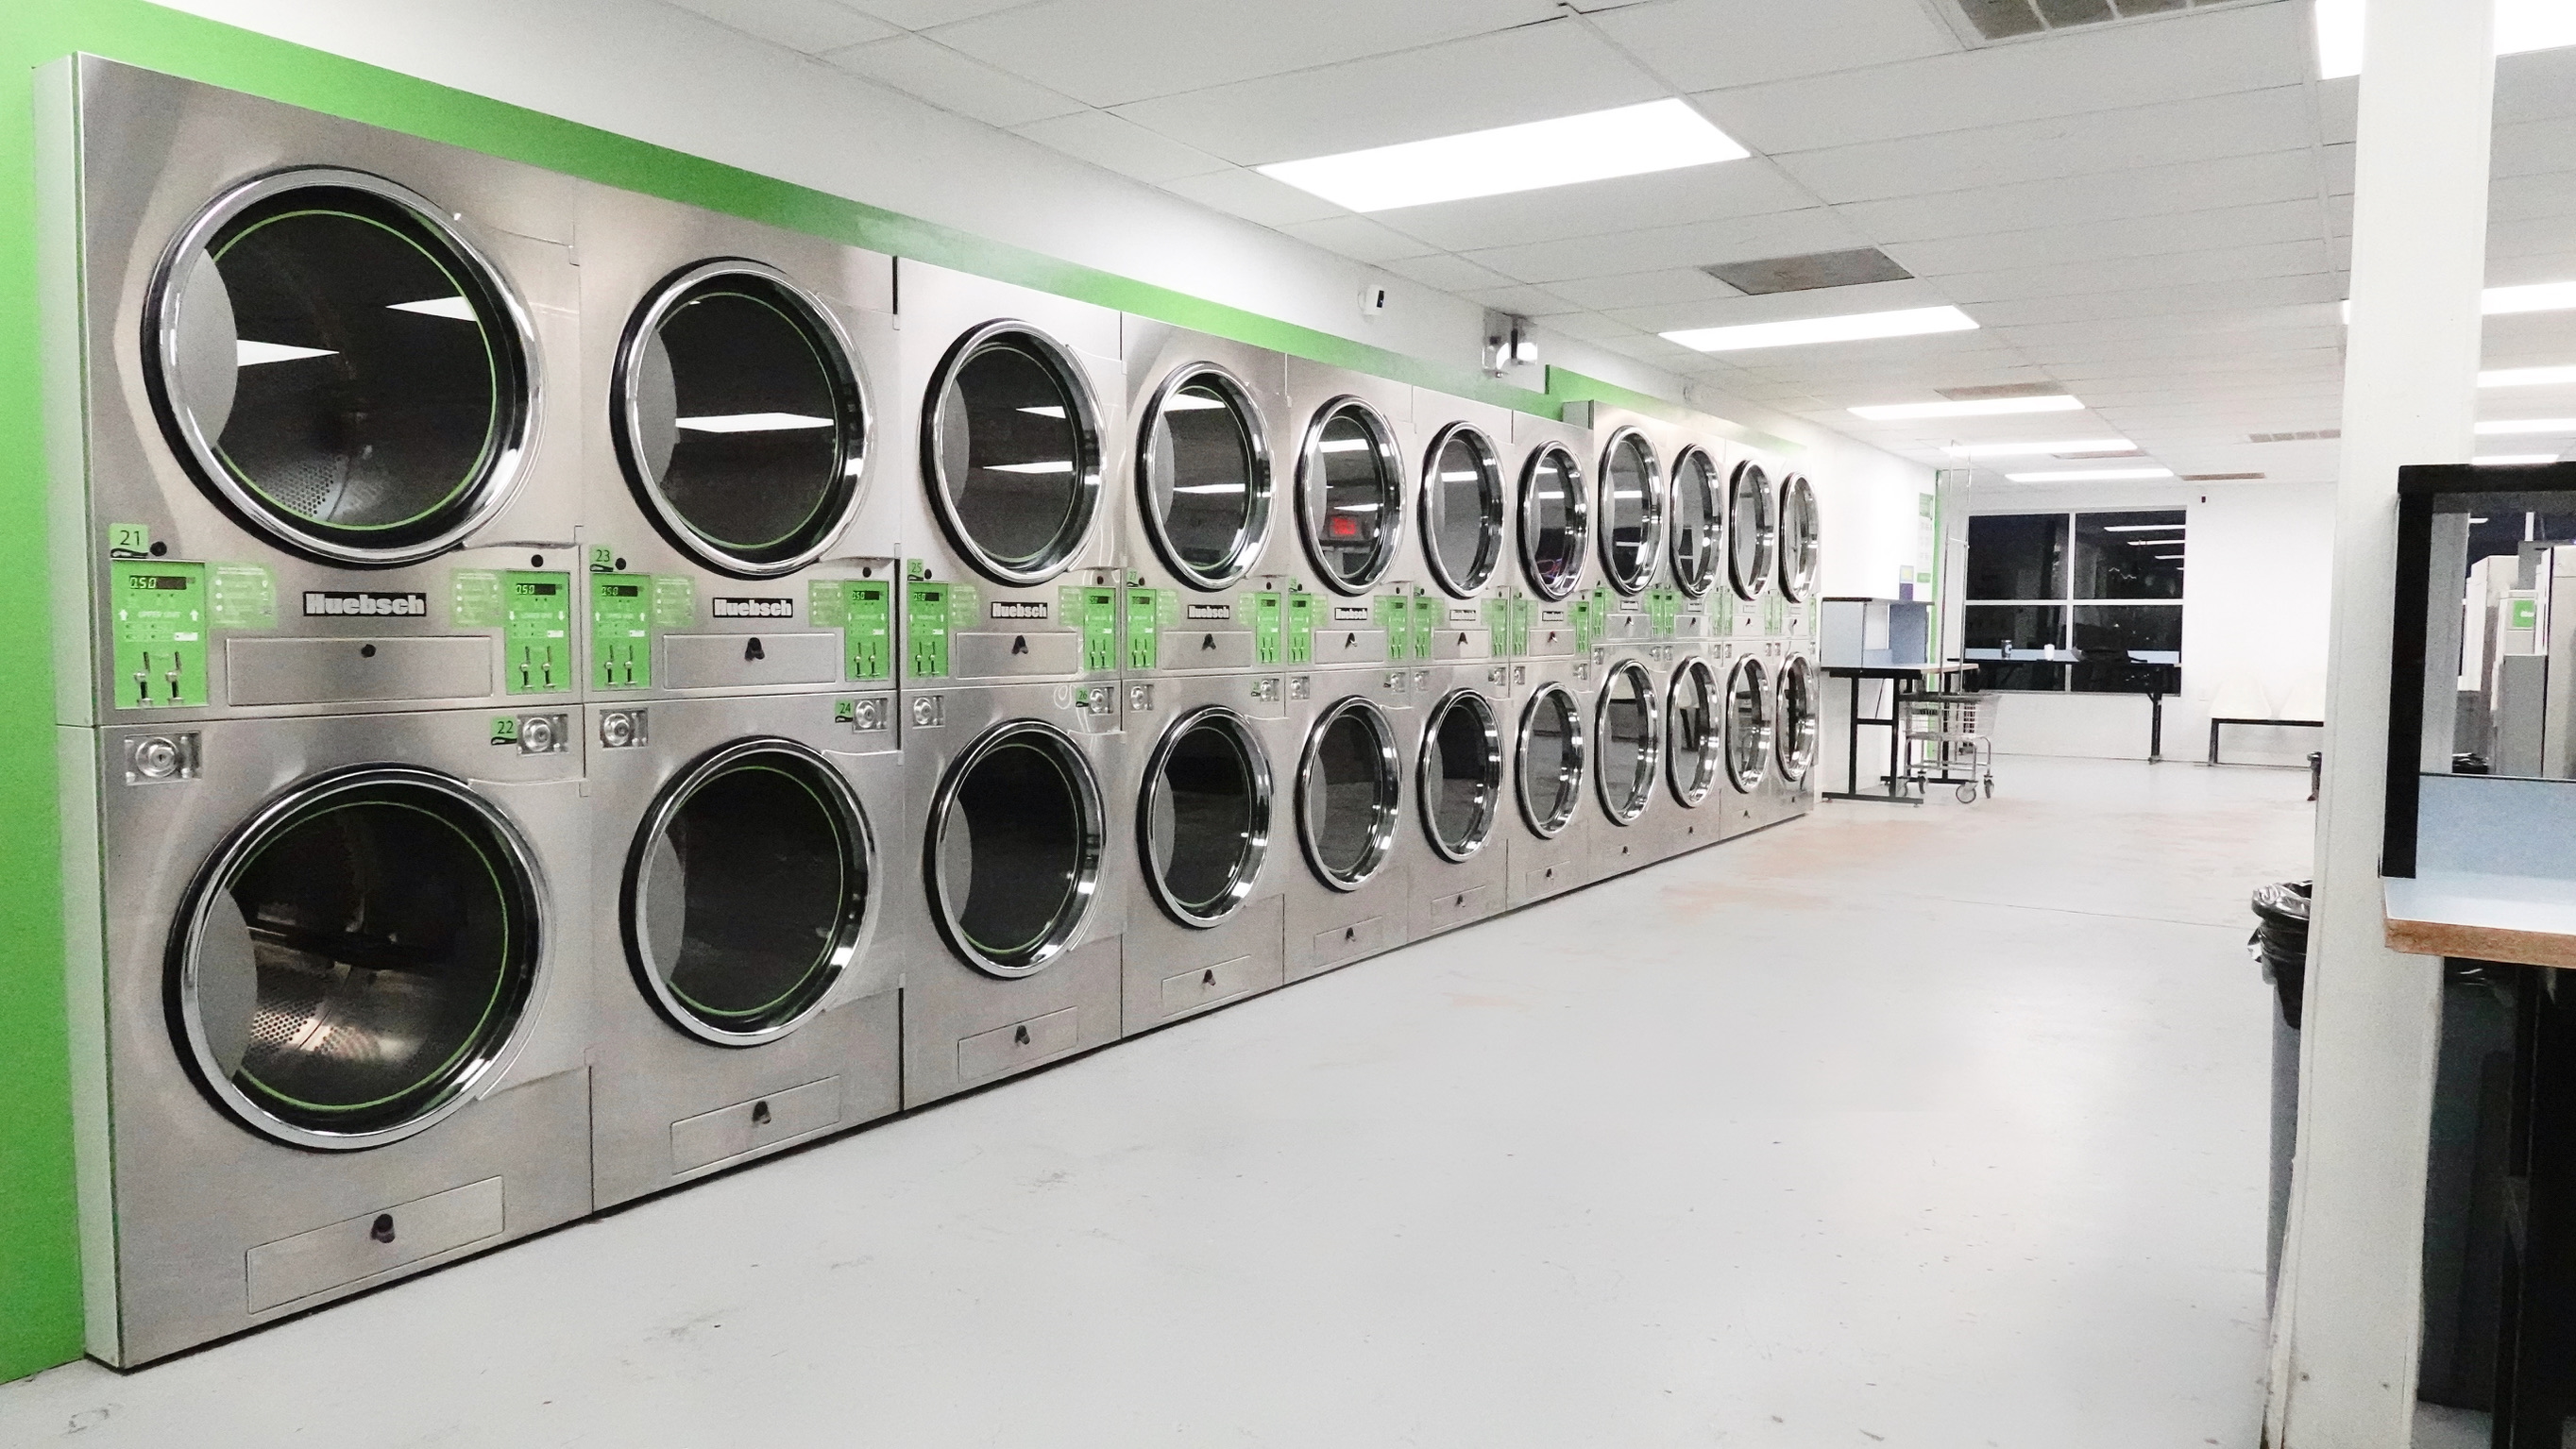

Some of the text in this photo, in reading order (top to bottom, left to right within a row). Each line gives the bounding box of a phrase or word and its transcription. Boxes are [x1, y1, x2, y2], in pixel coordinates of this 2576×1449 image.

[119, 530, 141, 547] 21
[595, 548, 611, 563] 23
[911, 562, 923, 573] 25
[305, 593, 425, 615] Huebsch
[714, 598, 792, 616] Huebsch
[992, 602, 1047, 618] Huebsch
[1078, 690, 1088, 700] 26
[839, 702, 852, 715] 24
[497, 719, 515, 734] 22
